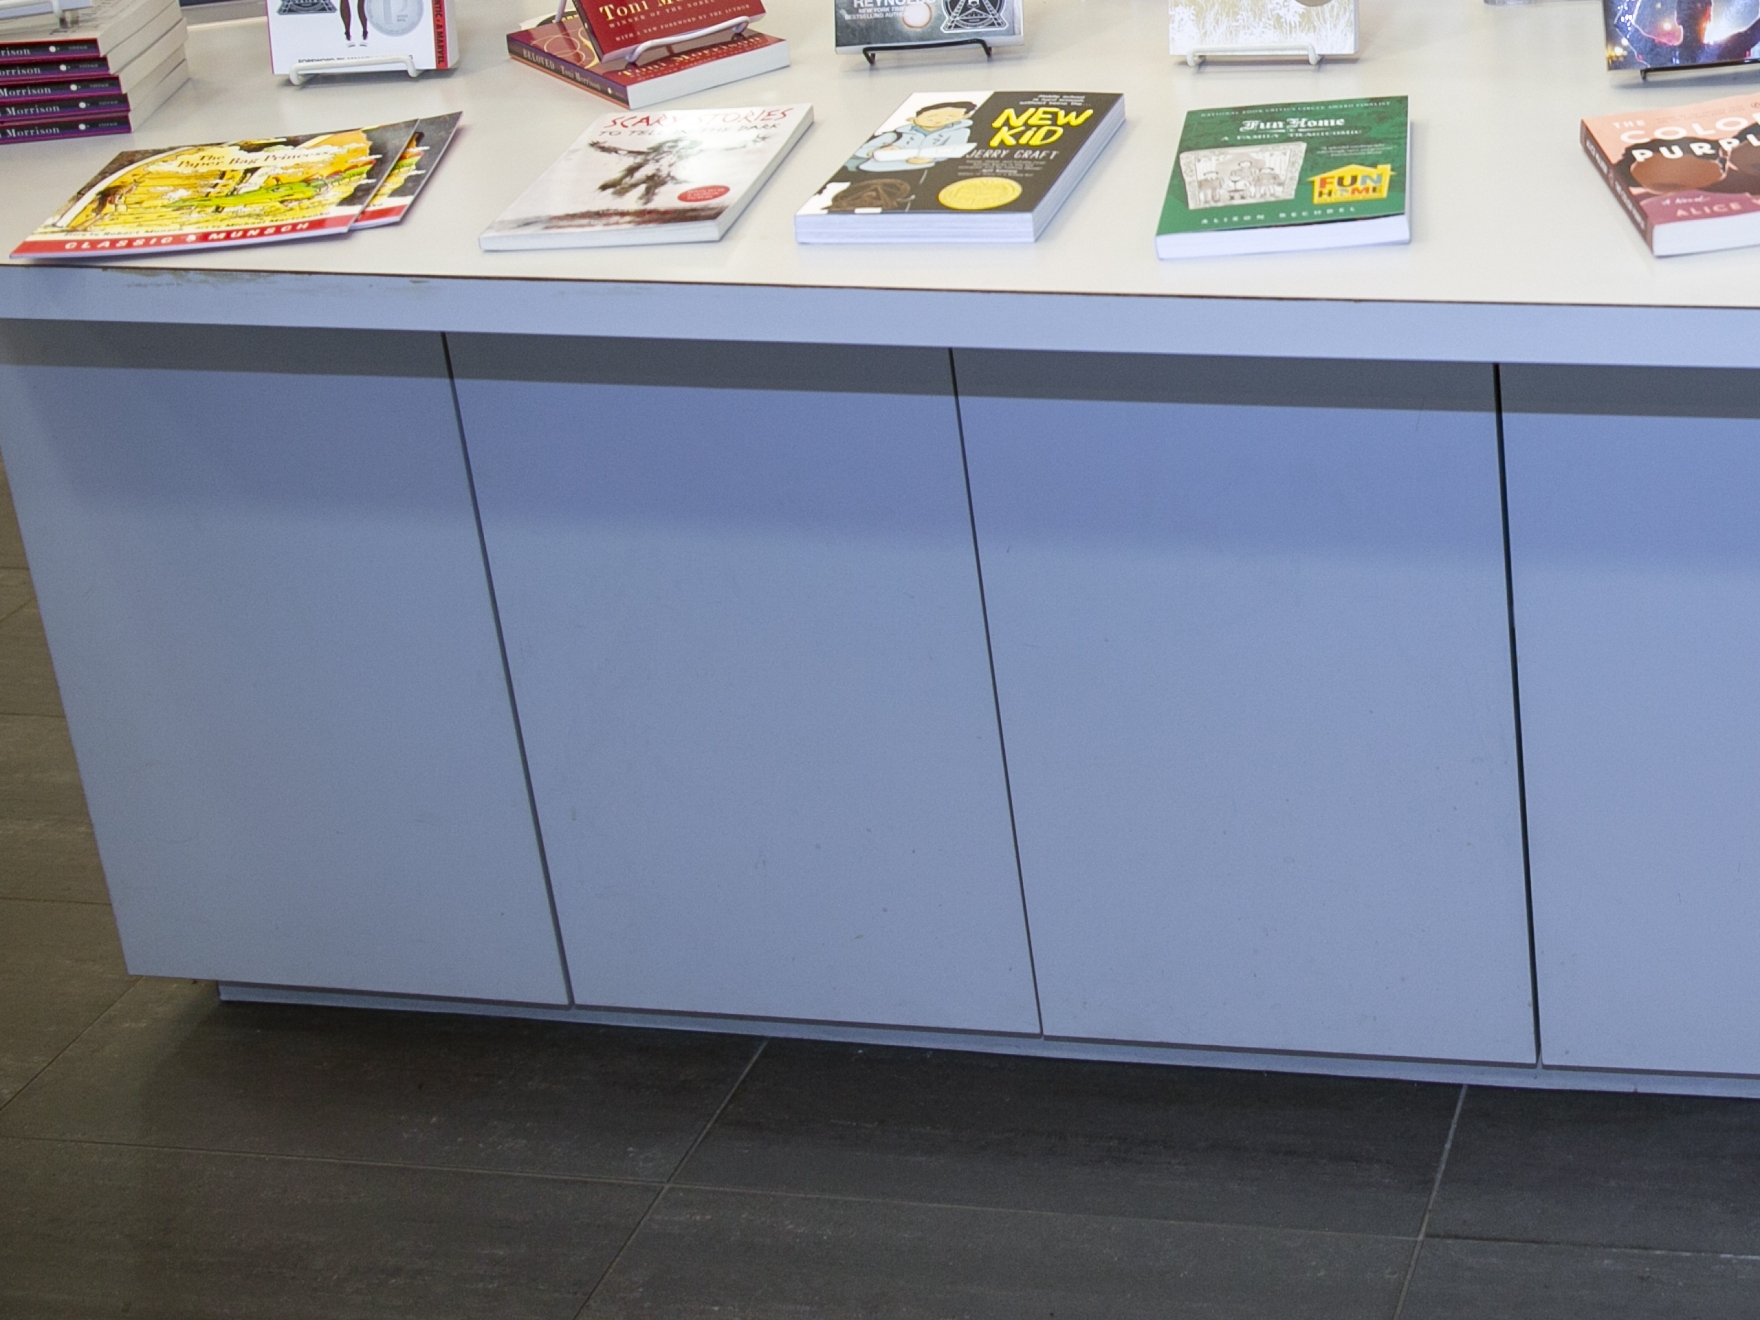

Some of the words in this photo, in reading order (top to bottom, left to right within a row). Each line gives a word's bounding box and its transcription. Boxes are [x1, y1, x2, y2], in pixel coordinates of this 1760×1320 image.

[436, 32, 445, 64] MARVEL
[522, 48, 556, 70] BELOVED
[5, 104, 60, 116] Morrison
[991, 108, 1094, 128] NEW
[1239, 120, 1285, 132] Fun
[1286, 118, 1345, 131] Home
[1613, 119, 1645, 129] THE
[5, 126, 60, 138] Morrison
[178, 158, 231, 169] Paper
[234, 155, 262, 167] Bag
[263, 149, 331, 164] Princess
[198, 153, 225, 162] The
[966, 149, 1009, 159] JERRY
[1014, 150, 1059, 159] CRAFT
[1319, 174, 1382, 190] FUN
[1201, 214, 1265, 225] ALISON
[1279, 207, 1355, 218] BECHDEL
[1676, 202, 1743, 217] ALICE
[65, 236, 173, 250] CLASSIC
[209, 222, 309, 241] MUNSCH
